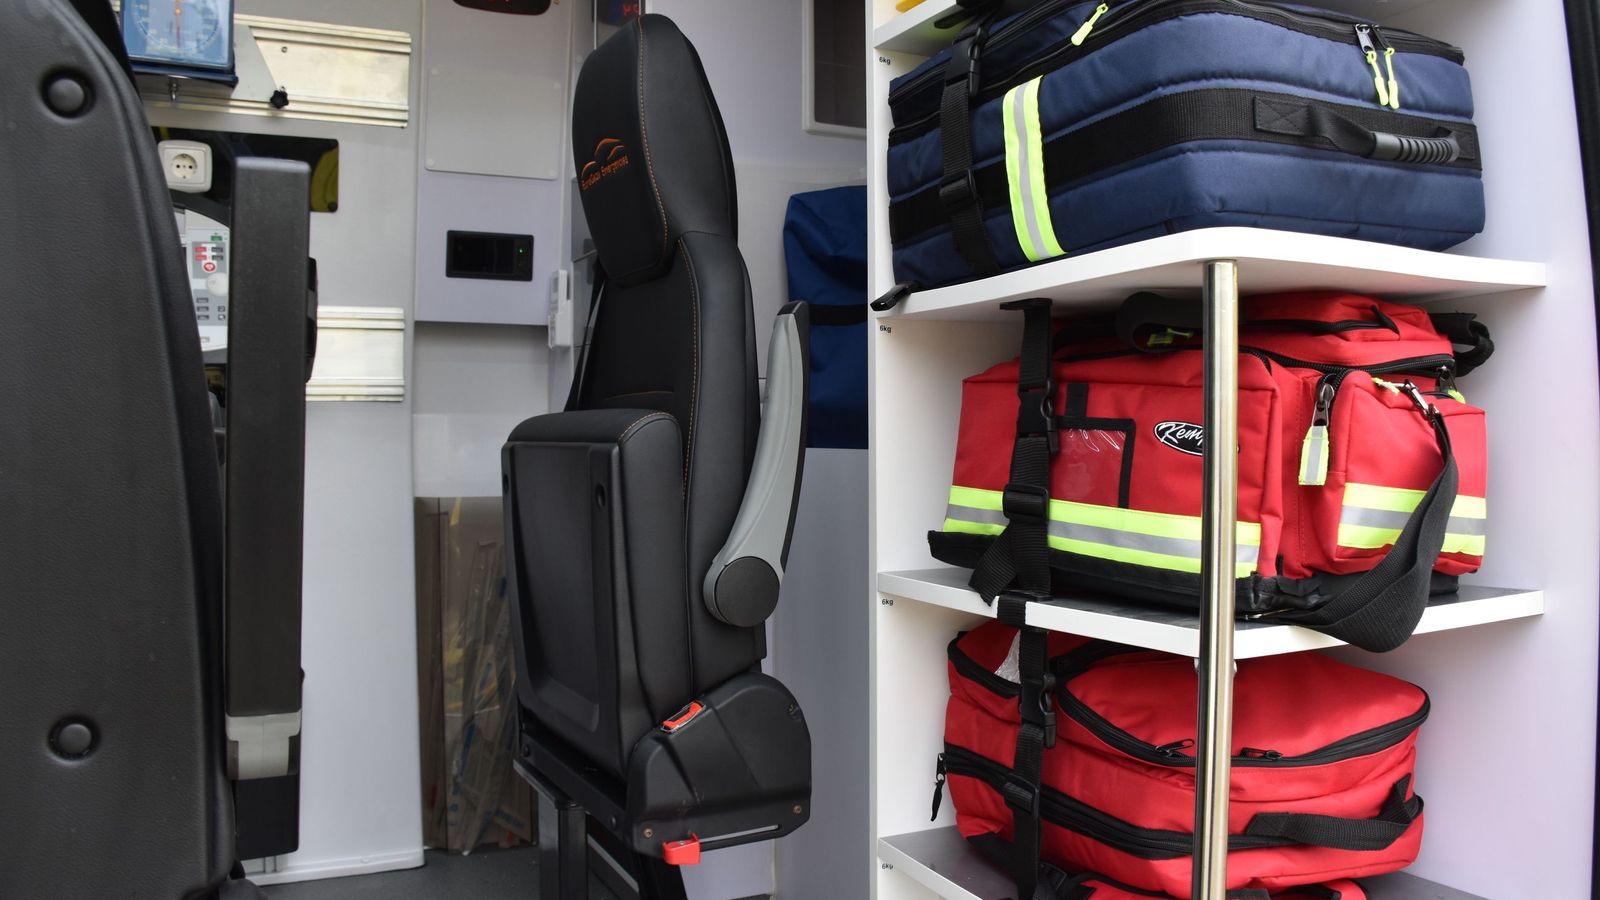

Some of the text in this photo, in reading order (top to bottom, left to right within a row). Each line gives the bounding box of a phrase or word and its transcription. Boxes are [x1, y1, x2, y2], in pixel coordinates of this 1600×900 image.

[879, 56, 891, 65] 6kg
[880, 325, 891, 334] 6kg
[881, 598, 893, 606] 6kg
